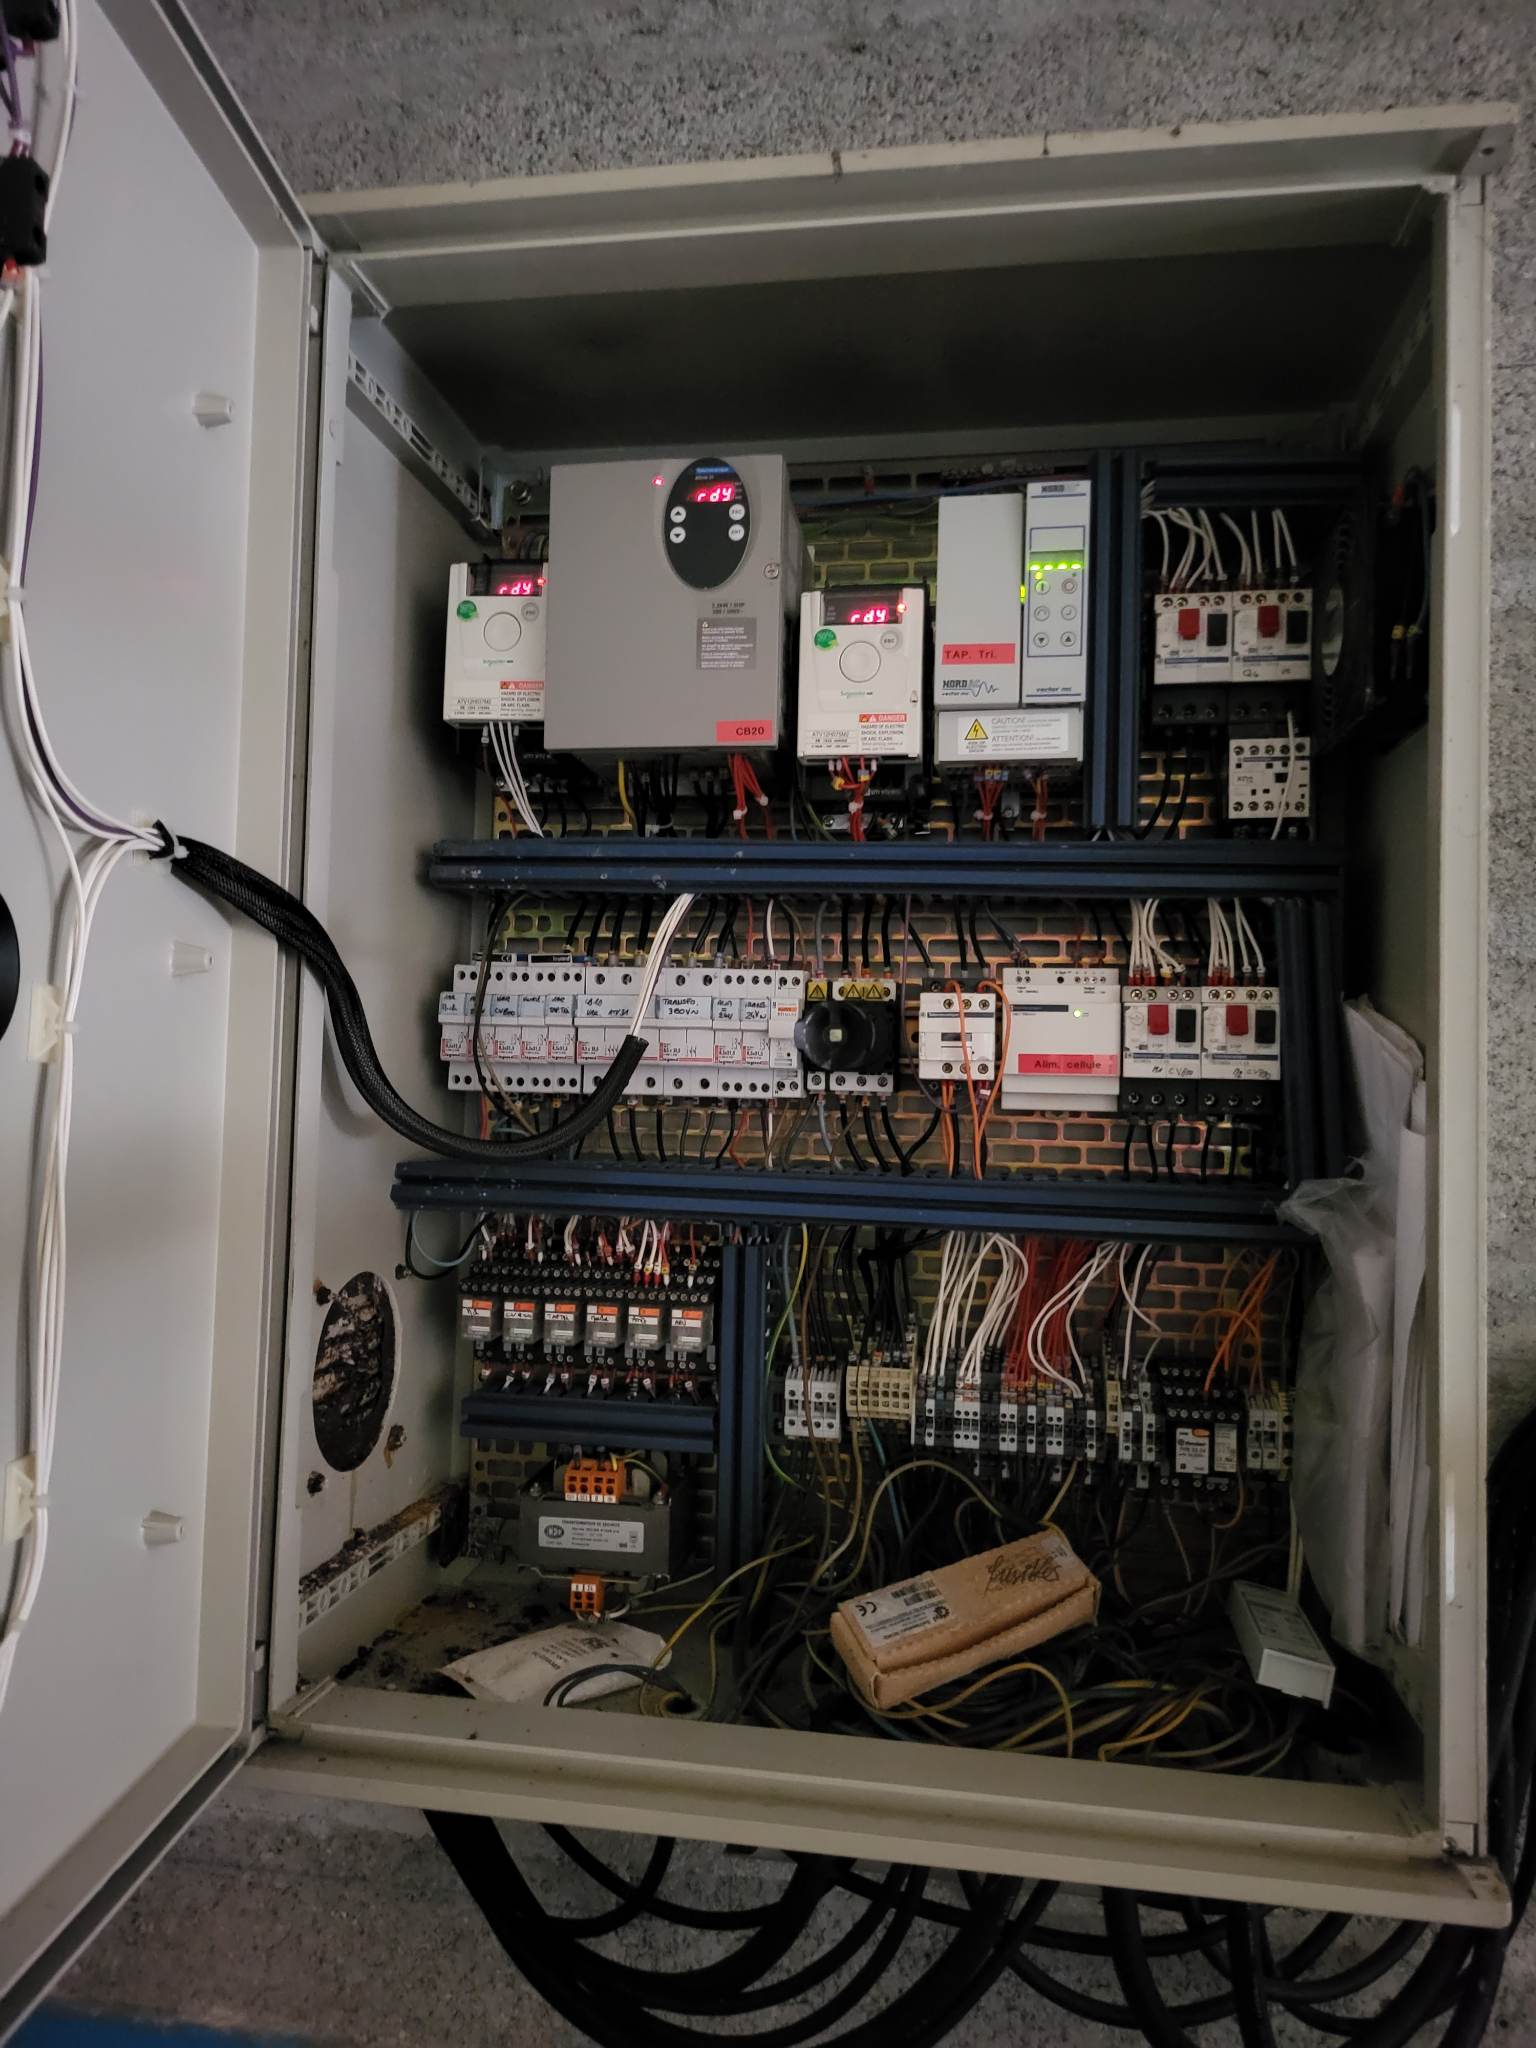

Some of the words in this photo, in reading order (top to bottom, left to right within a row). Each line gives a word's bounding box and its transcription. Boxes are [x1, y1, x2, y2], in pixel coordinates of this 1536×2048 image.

[697, 487, 732, 502] rdy
[499, 583, 532, 595] rdy
[850, 609, 887, 623] rdy
[944, 650, 972, 660] TAP.
[735, 726, 765, 736] CB20
[1034, 1060, 1060, 1069] Alim.
[1066, 1060, 1102, 1069] cellule
[855, 1601, 877, 1617] CE
